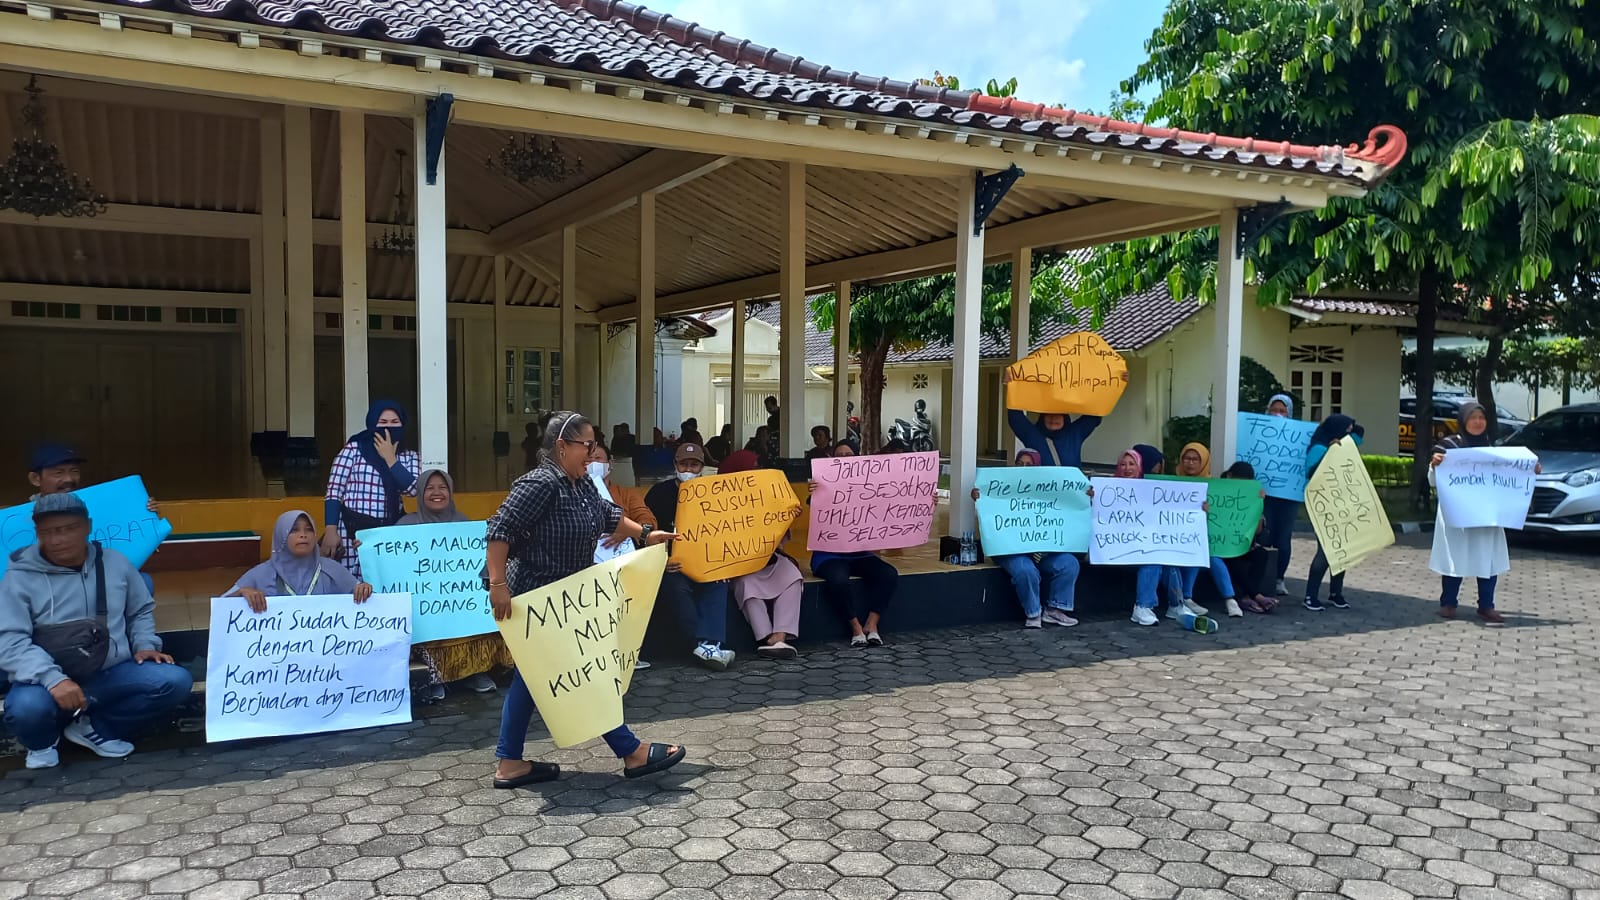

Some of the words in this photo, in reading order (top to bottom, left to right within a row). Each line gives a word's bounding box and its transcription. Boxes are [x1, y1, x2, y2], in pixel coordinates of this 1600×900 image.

[711, 475, 757, 495] GAWE
[987, 480, 1011, 497] Pie
[1100, 485, 1138, 508] ORA
[700, 489, 764, 516] RUSUH
[682, 514, 754, 543] WAYAHE
[1097, 510, 1145, 527] LAPAK
[373, 540, 419, 555] TERAS
[705, 533, 776, 563] LAWUH
[413, 558, 483, 576] BUKAN
[440, 580, 485, 595] KAMU
[420, 597, 477, 616] DOANG
[525, 567, 625, 640] MACAK
[227, 609, 283, 633] Kami
[289, 609, 350, 630] Sudah
[354, 611, 410, 634] Bosan
[247, 634, 315, 664] dengan
[225, 664, 279, 688] Kami
[286, 663, 344, 685] Butuh
[221, 691, 309, 716] Berjualan
[346, 685, 406, 714] Tenang
